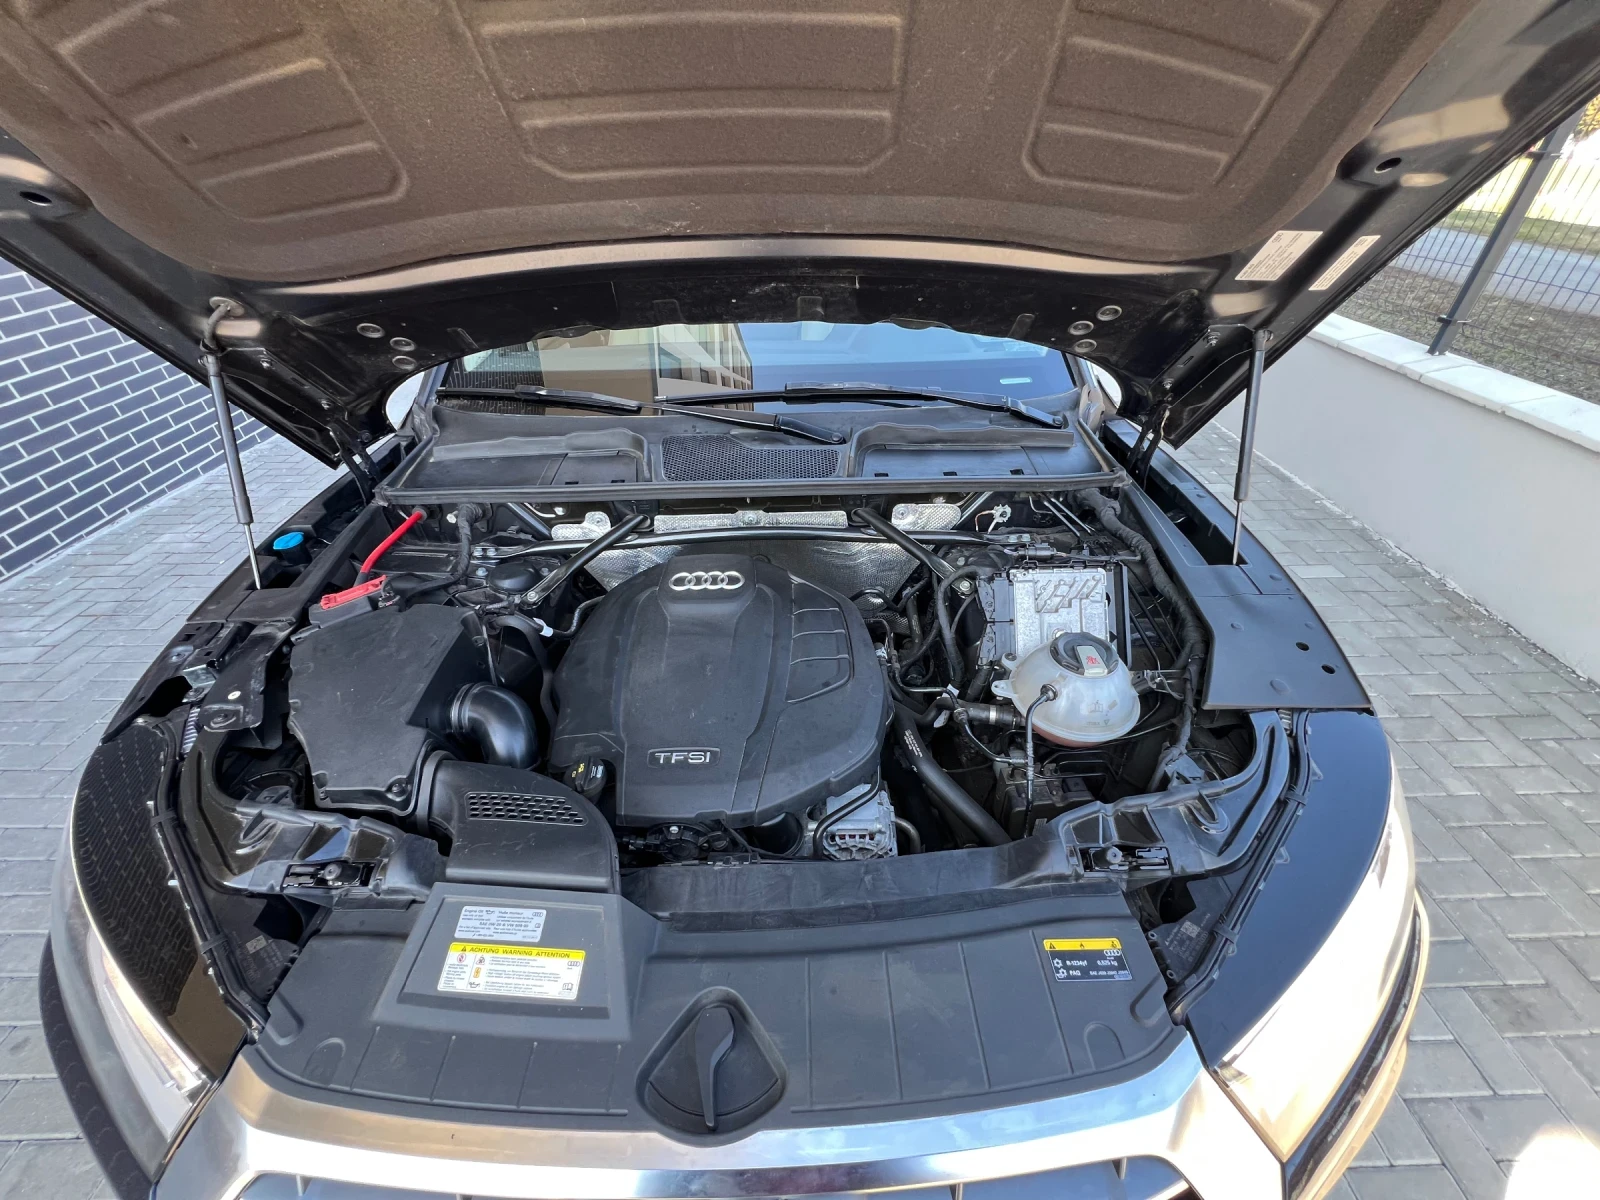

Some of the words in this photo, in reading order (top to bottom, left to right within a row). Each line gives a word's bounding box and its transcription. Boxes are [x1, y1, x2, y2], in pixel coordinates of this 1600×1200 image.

[655, 751, 711, 764] TFSI
[469, 946, 499, 954] ACHTUNG
[502, 948, 533, 956] WARNING
[535, 951, 571, 959] ATTENTION
